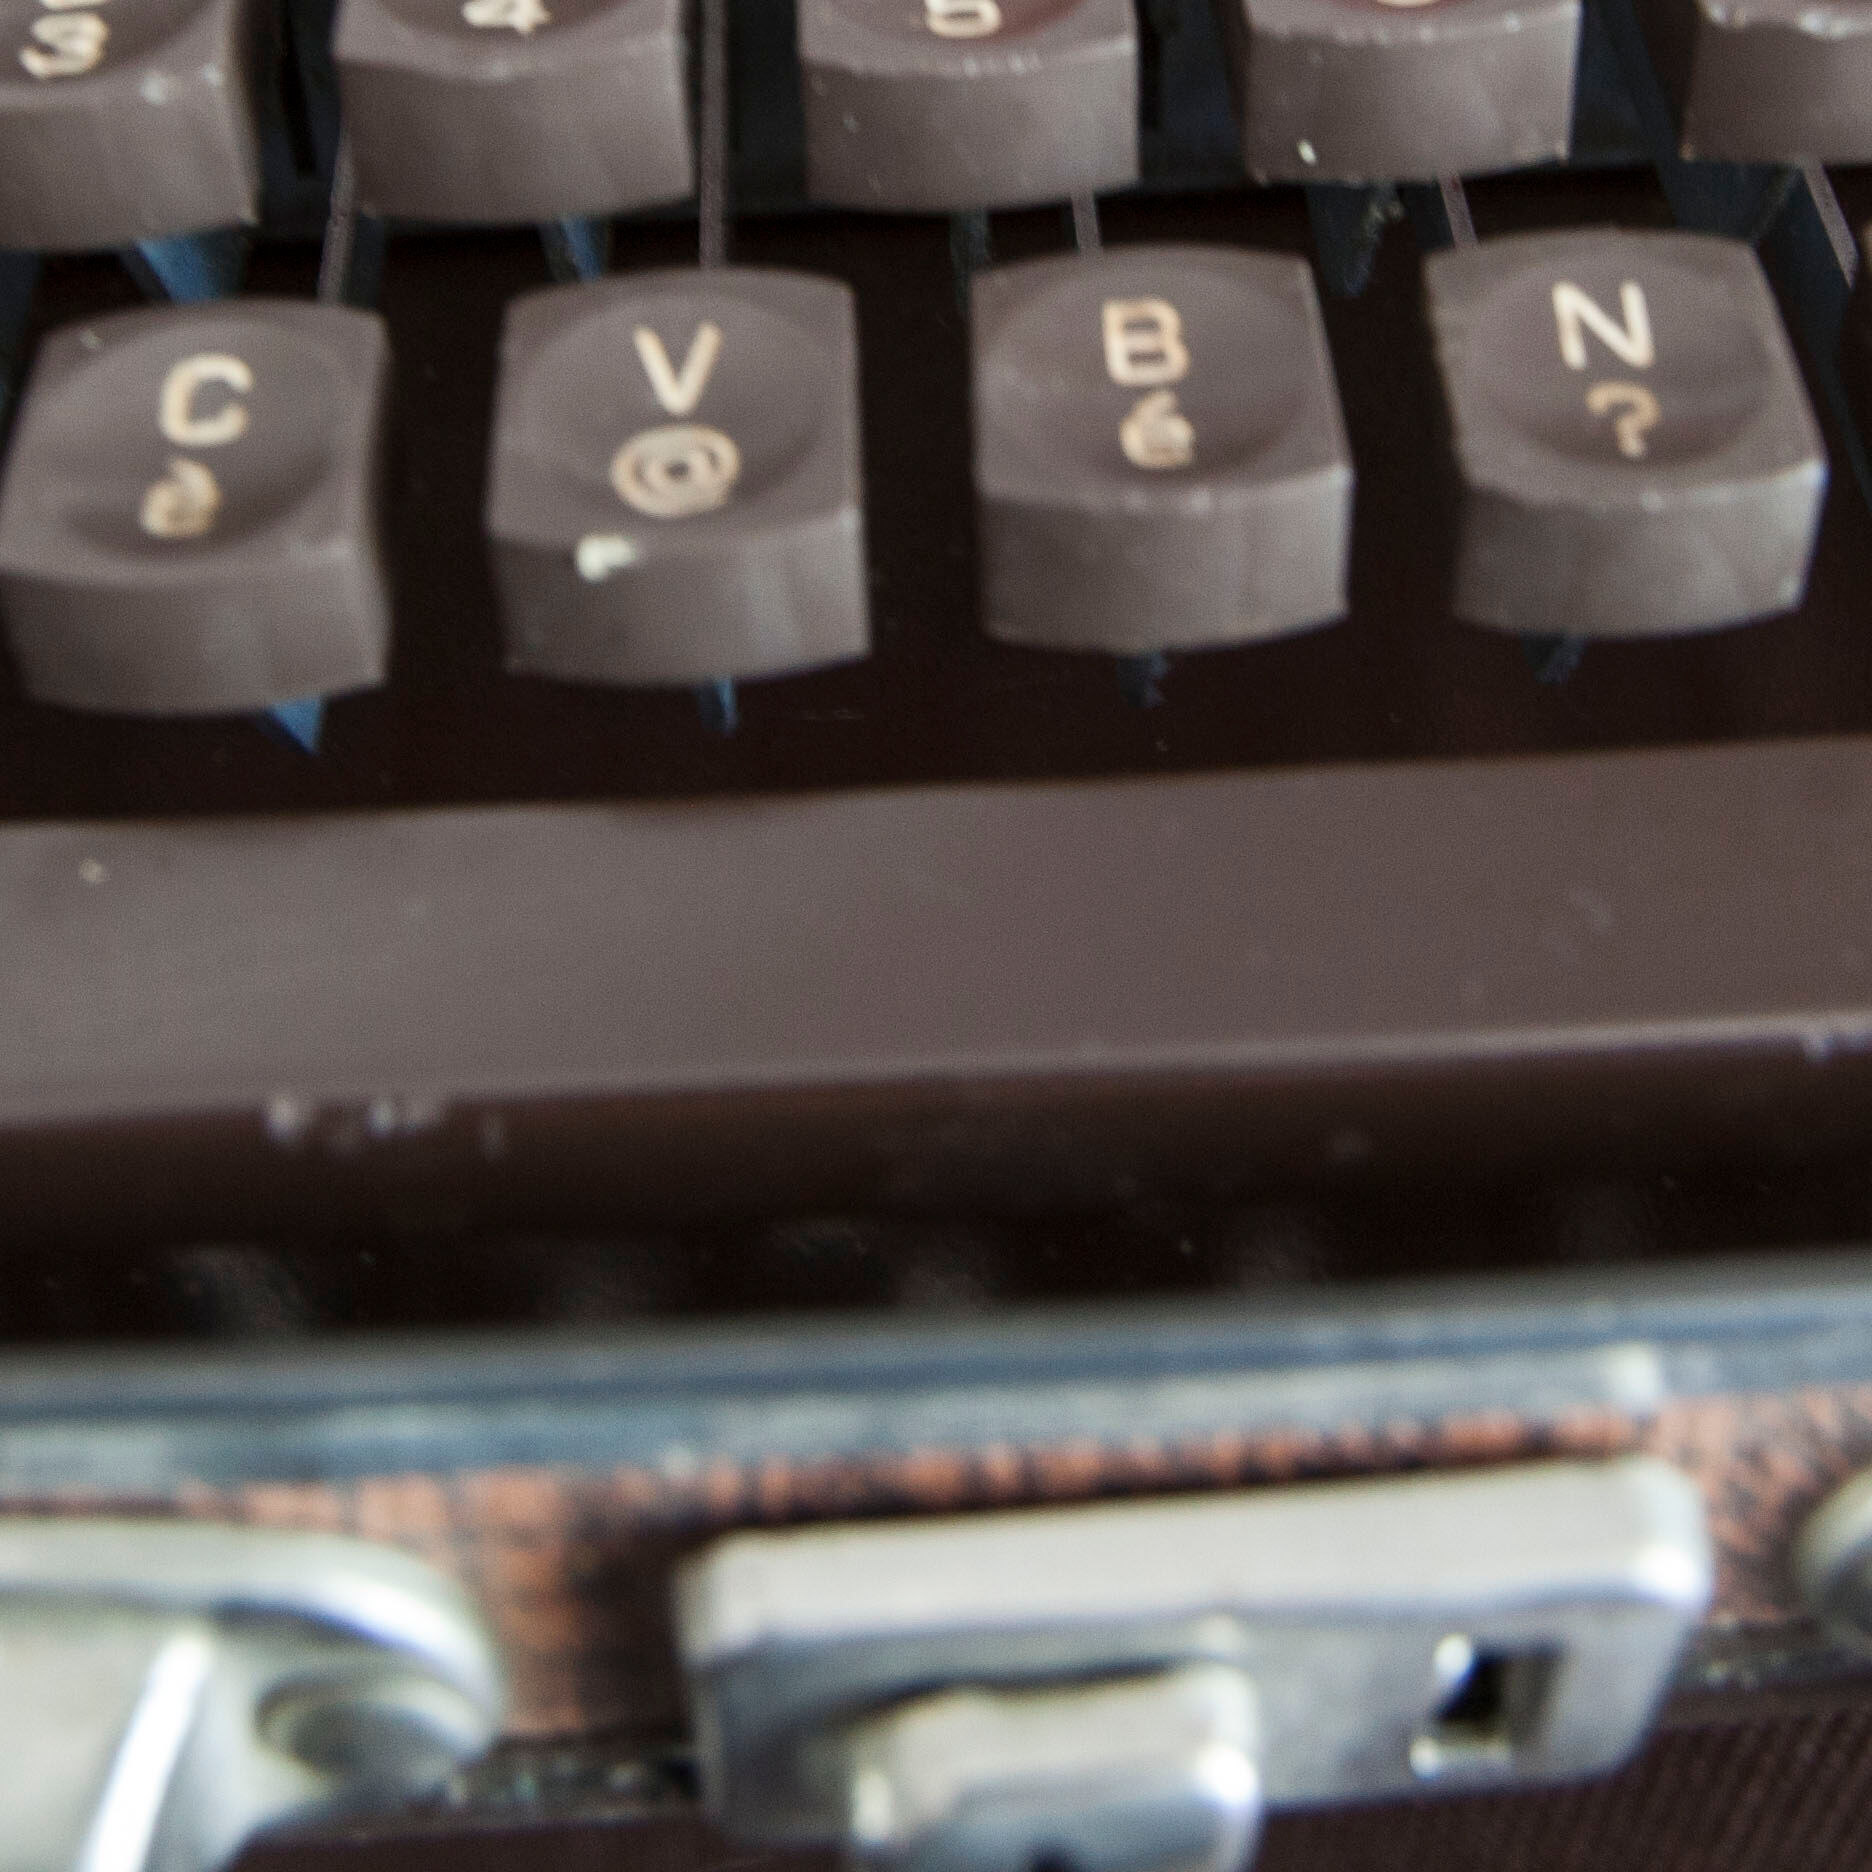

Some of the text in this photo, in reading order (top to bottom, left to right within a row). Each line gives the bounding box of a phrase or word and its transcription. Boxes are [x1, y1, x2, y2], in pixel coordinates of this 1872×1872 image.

[19, 11, 109, 78] 3
[633, 320, 724, 416] V
[1101, 294, 1191, 387] B
[1550, 280, 1657, 370] N
[159, 352, 256, 449] C
[1585, 379, 1662, 459] ?
